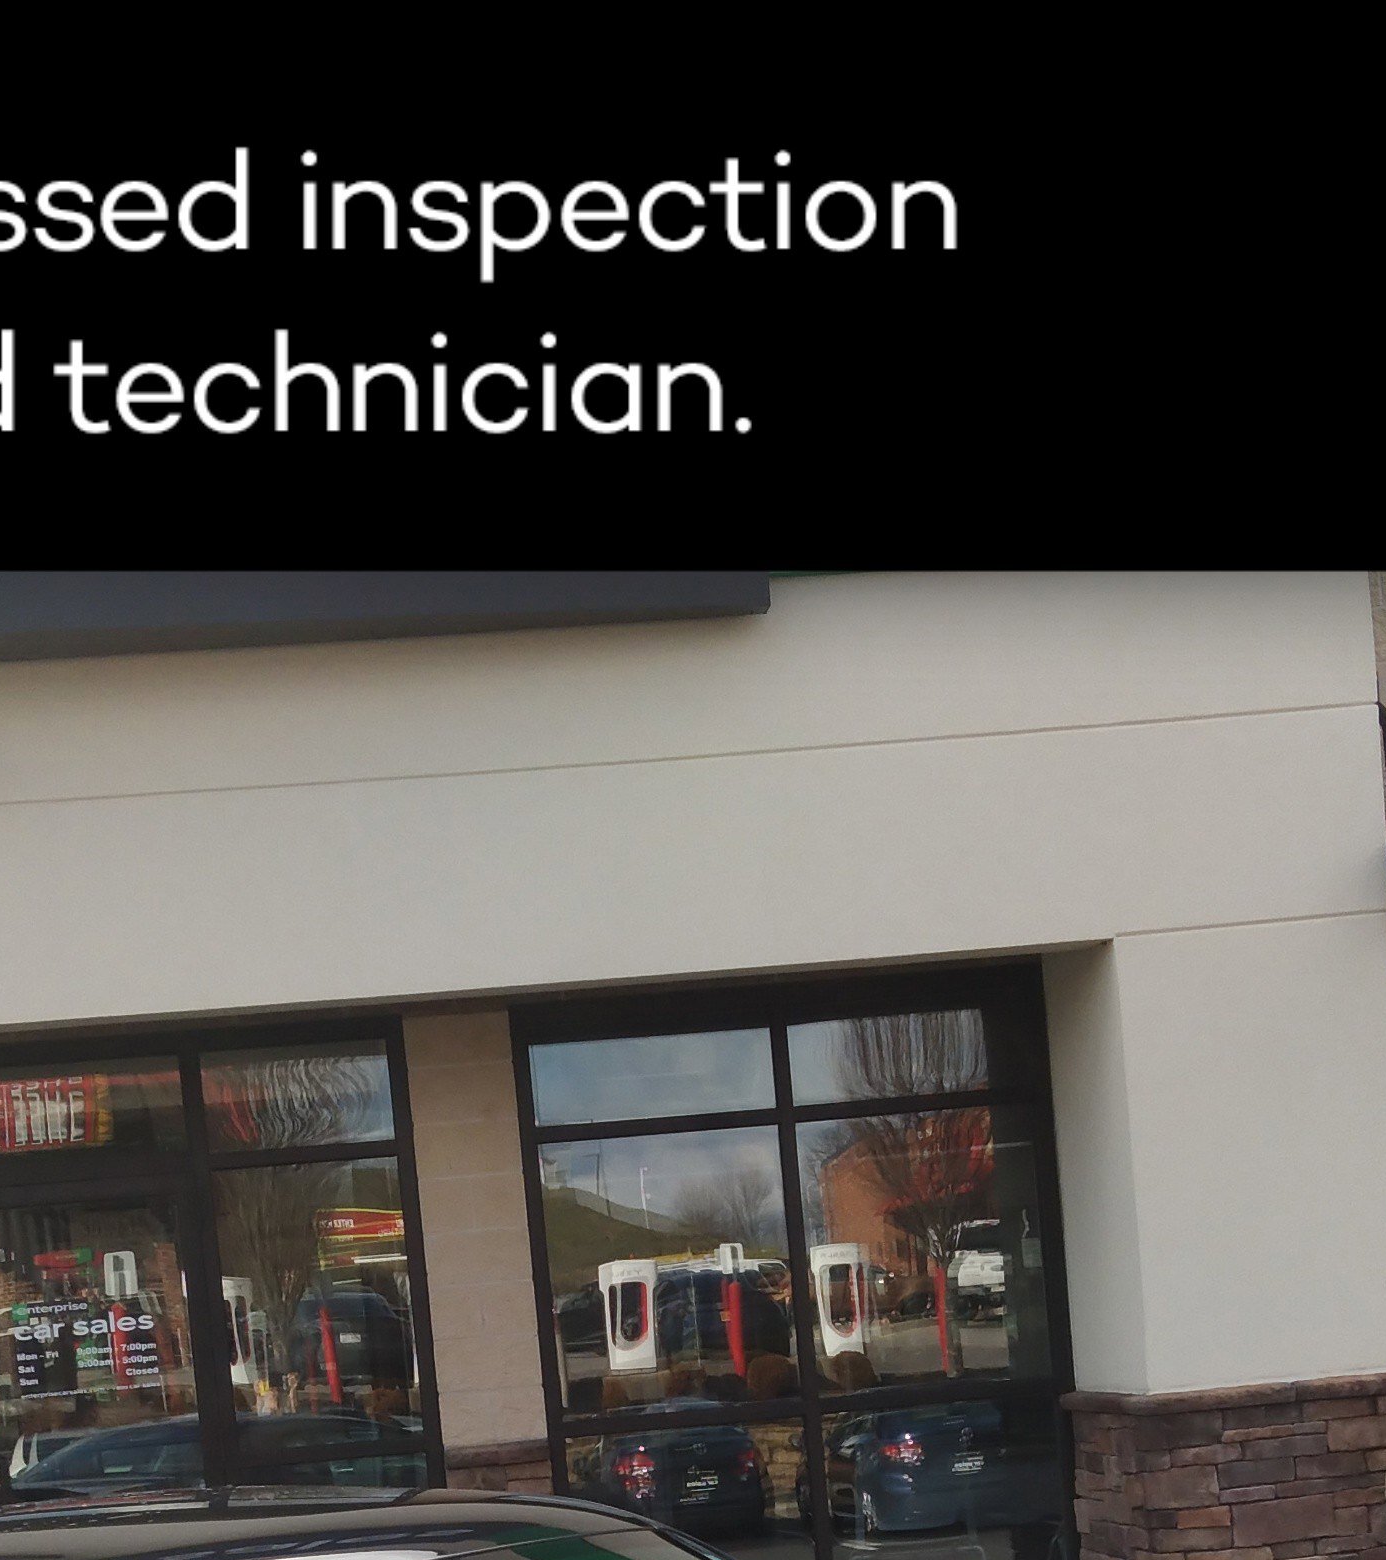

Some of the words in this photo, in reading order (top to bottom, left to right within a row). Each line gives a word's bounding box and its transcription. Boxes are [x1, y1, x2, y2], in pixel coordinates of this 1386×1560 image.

[16, 1302, 88, 1315] enterprise
[14, 1323, 66, 1341] car
[72, 1311, 155, 1336] sales
[16, 1353, 38, 1361] Mon
[45, 1351, 59, 1359] Fri
[120, 1342, 157, 1352] 7:00pm
[18, 1365, 35, 1374] Sat
[77, 1359, 113, 1368] 9:00am
[19, 1378, 39, 1386] Sun
[125, 1367, 159, 1376] Closed
